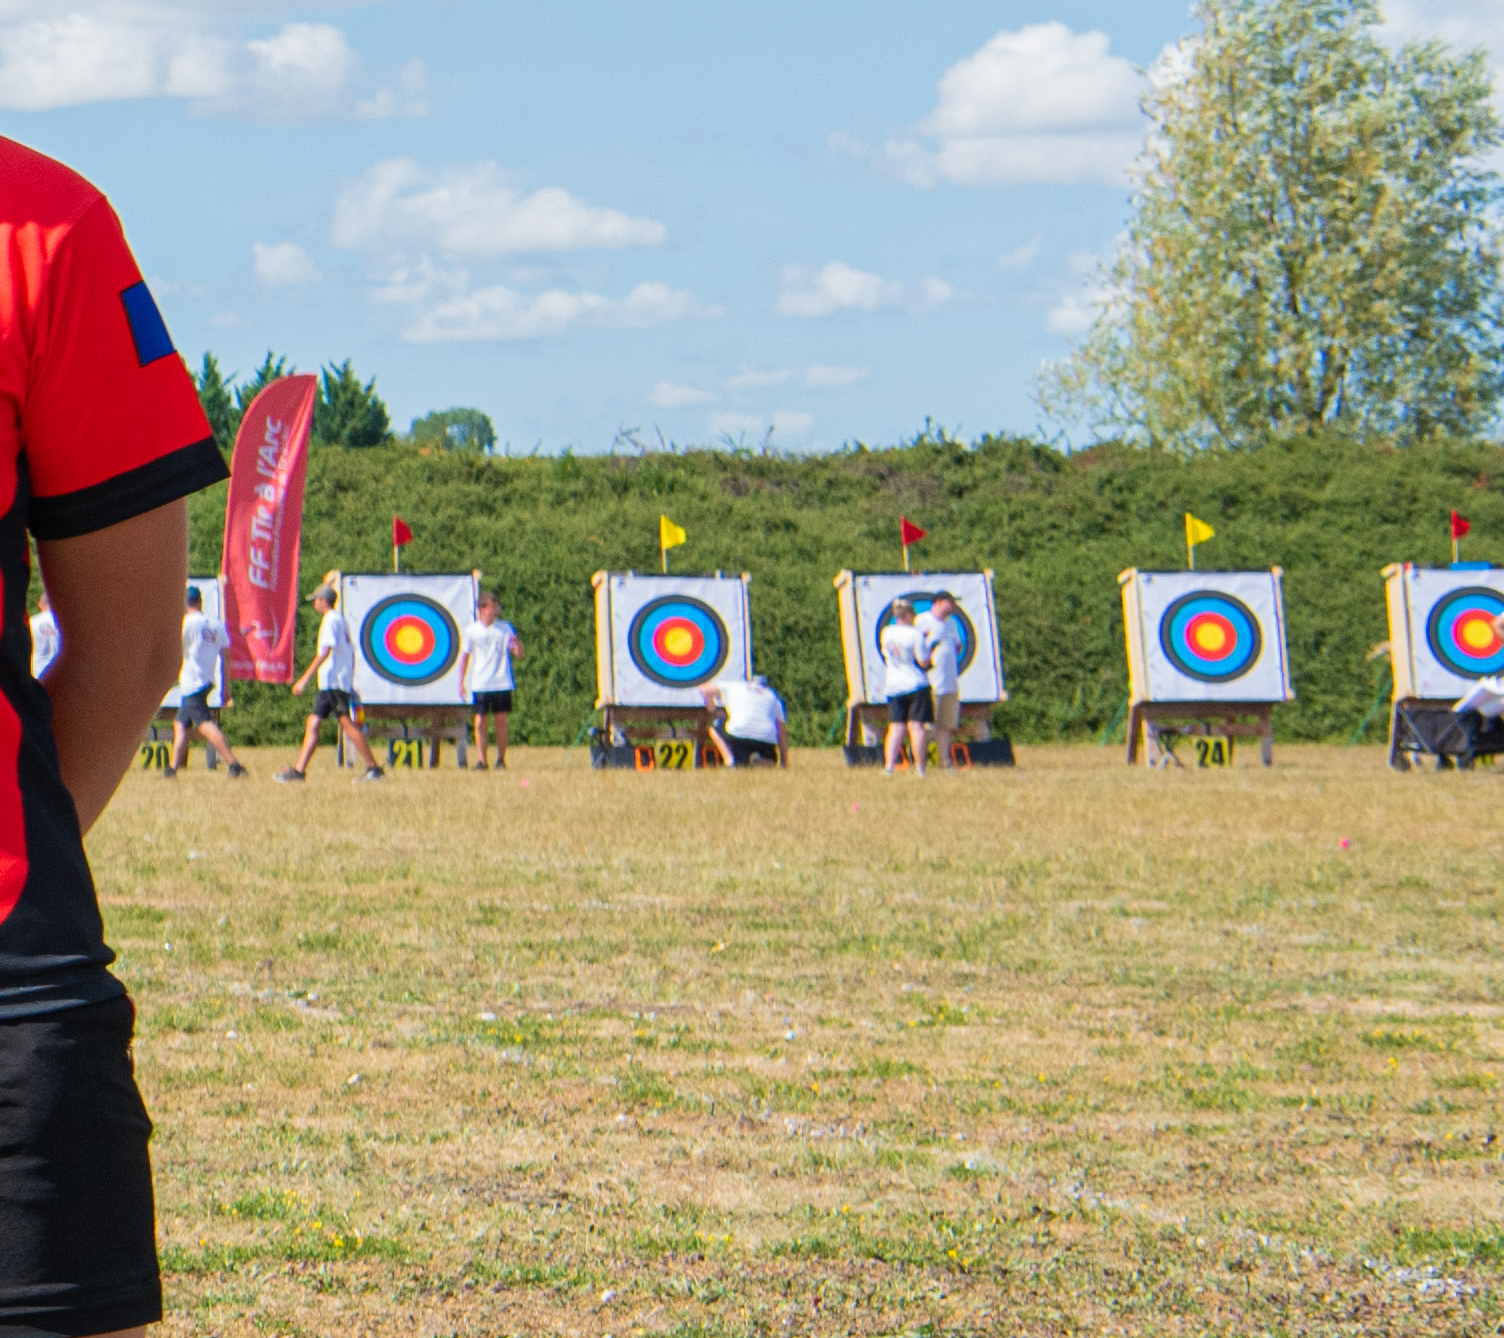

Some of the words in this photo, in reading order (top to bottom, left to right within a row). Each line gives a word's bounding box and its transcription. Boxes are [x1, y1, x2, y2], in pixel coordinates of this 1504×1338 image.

[256, 415, 283, 477] l'Arc
[251, 504, 274, 542] Tir
[248, 546, 270, 590] FF
[141, 744, 170, 770] 20
[392, 741, 422, 768] 21
[659, 744, 688, 769] 22
[1195, 740, 1224, 768] 24
